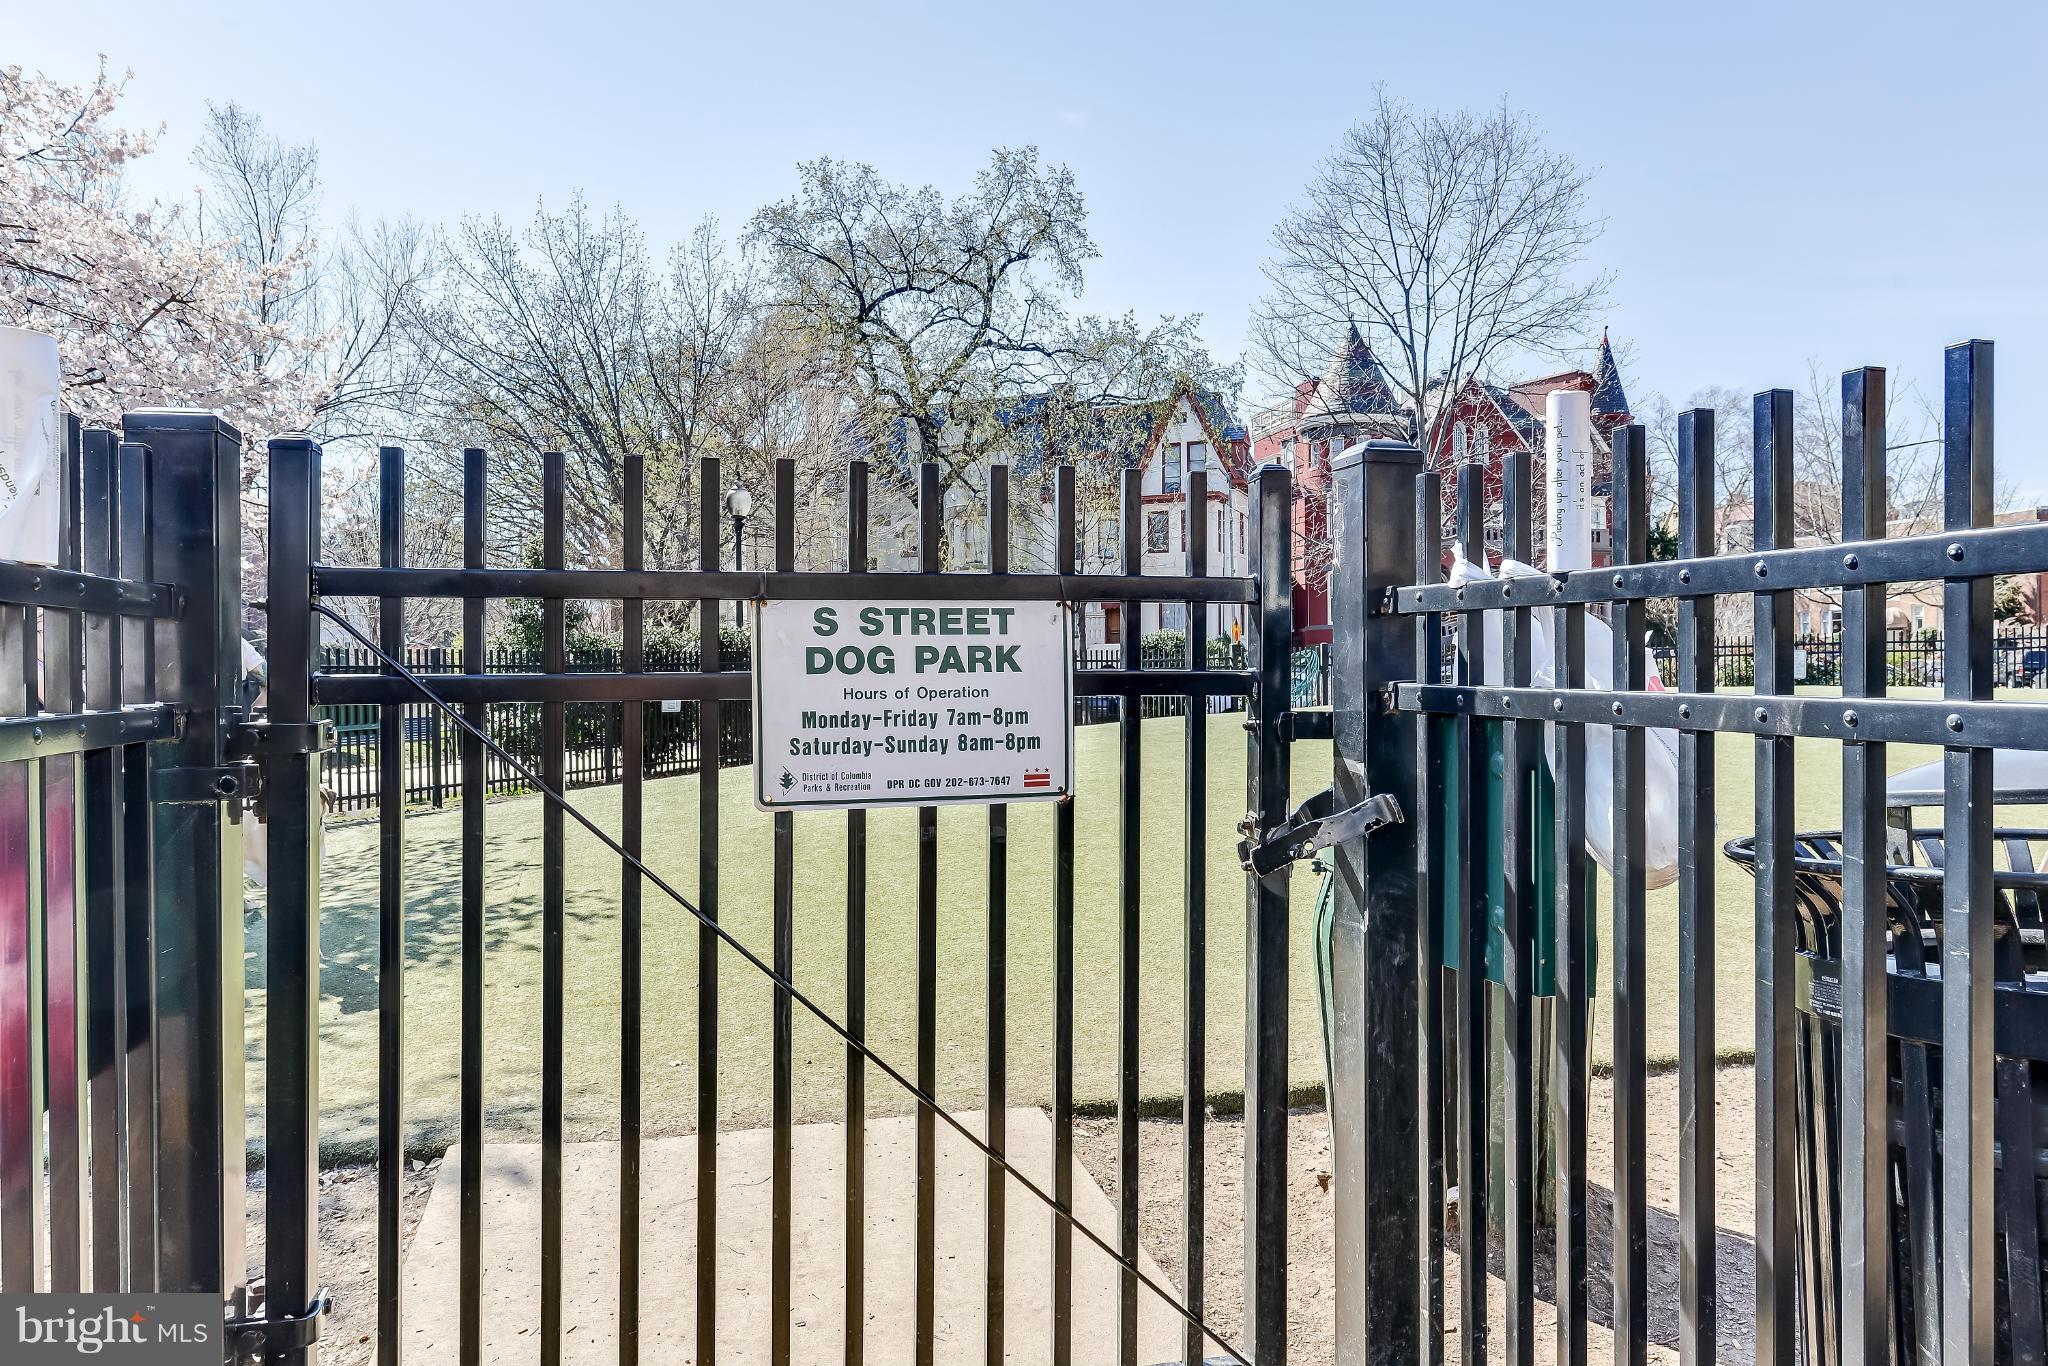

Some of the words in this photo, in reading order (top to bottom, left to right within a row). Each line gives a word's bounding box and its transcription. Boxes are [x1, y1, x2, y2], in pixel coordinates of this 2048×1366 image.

[1557, 445, 1569, 463] your
[1571, 449, 1588, 460] of
[1551, 467, 1568, 488] after
[1576, 464, 1585, 477] act
[1579, 482, 1585, 493] an
[1557, 492, 1568, 504] up
[1572, 498, 1585, 510] it's
[1550, 508, 1566, 547] Picking
[813, 607, 839, 637] S
[859, 607, 1015, 637] STREET
[805, 645, 896, 676] DOG
[914, 645, 1023, 674] PARK
[843, 687, 888, 701] Hours
[895, 686, 910, 701] of
[917, 686, 990, 702] Operation
[801, 709, 938, 731] Monday-Friday
[946, 707, 1029, 728] 7am-8pm
[789, 735, 950, 757] Saturday-Sunday
[957, 733, 1042, 753] 8am-8pm
[802, 772, 829, 782] District
[831, 772, 838, 781] of
[840, 771, 872, 781] Columbia
[887, 779, 905, 789] DPR
[908, 779, 921, 789] DC
[924, 778, 942, 788] GOV
[945, 776, 1011, 787] 202-673-7647
[803, 784, 823, 793] Parks
[826, 783, 831, 792] &
[834, 783, 871, 792] Recreation
